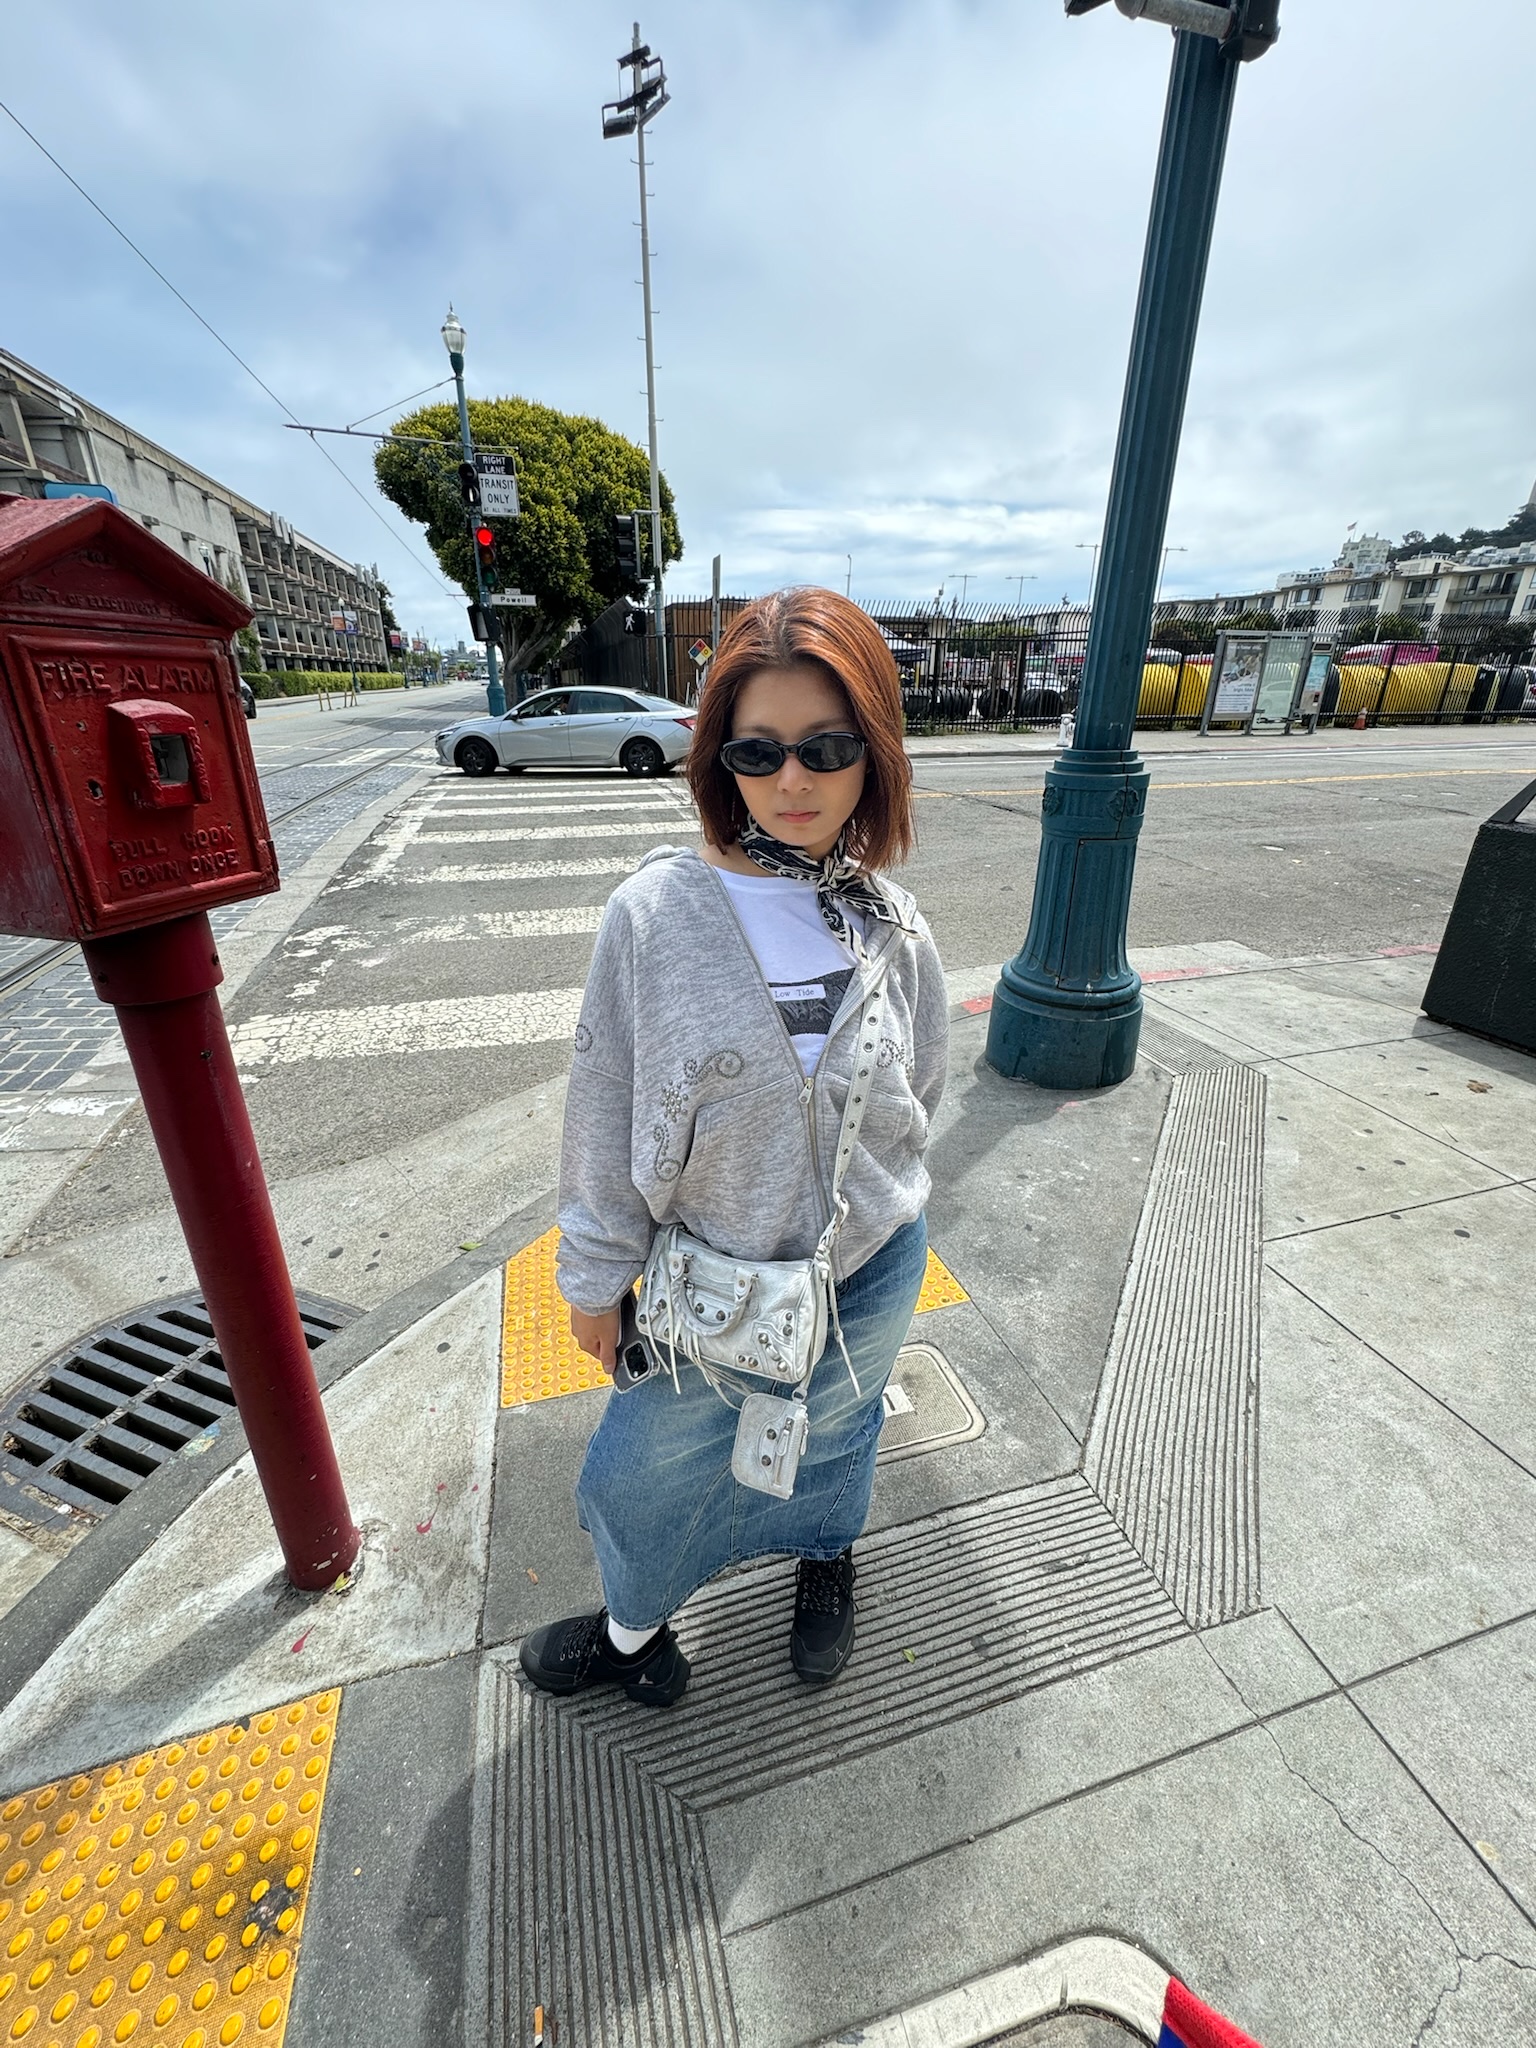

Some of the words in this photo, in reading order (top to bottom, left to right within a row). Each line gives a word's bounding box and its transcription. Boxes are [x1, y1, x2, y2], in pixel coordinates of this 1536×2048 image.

[482, 456, 506, 465] RIGHT
[485, 465, 507, 475] LANE
[480, 478, 514, 490] TRANSIT
[487, 493, 510, 504] ONLY
[38, 660, 111, 692] FIRE
[122, 664, 216, 693] ALARM
[110, 837, 168, 863] PULL
[182, 825, 235, 850] HOOK
[119, 860, 182, 888] DOWN
[190, 848, 239, 873] ONCE
[774, 990, 791, 998] Low
[796, 988, 815, 997] Tide
